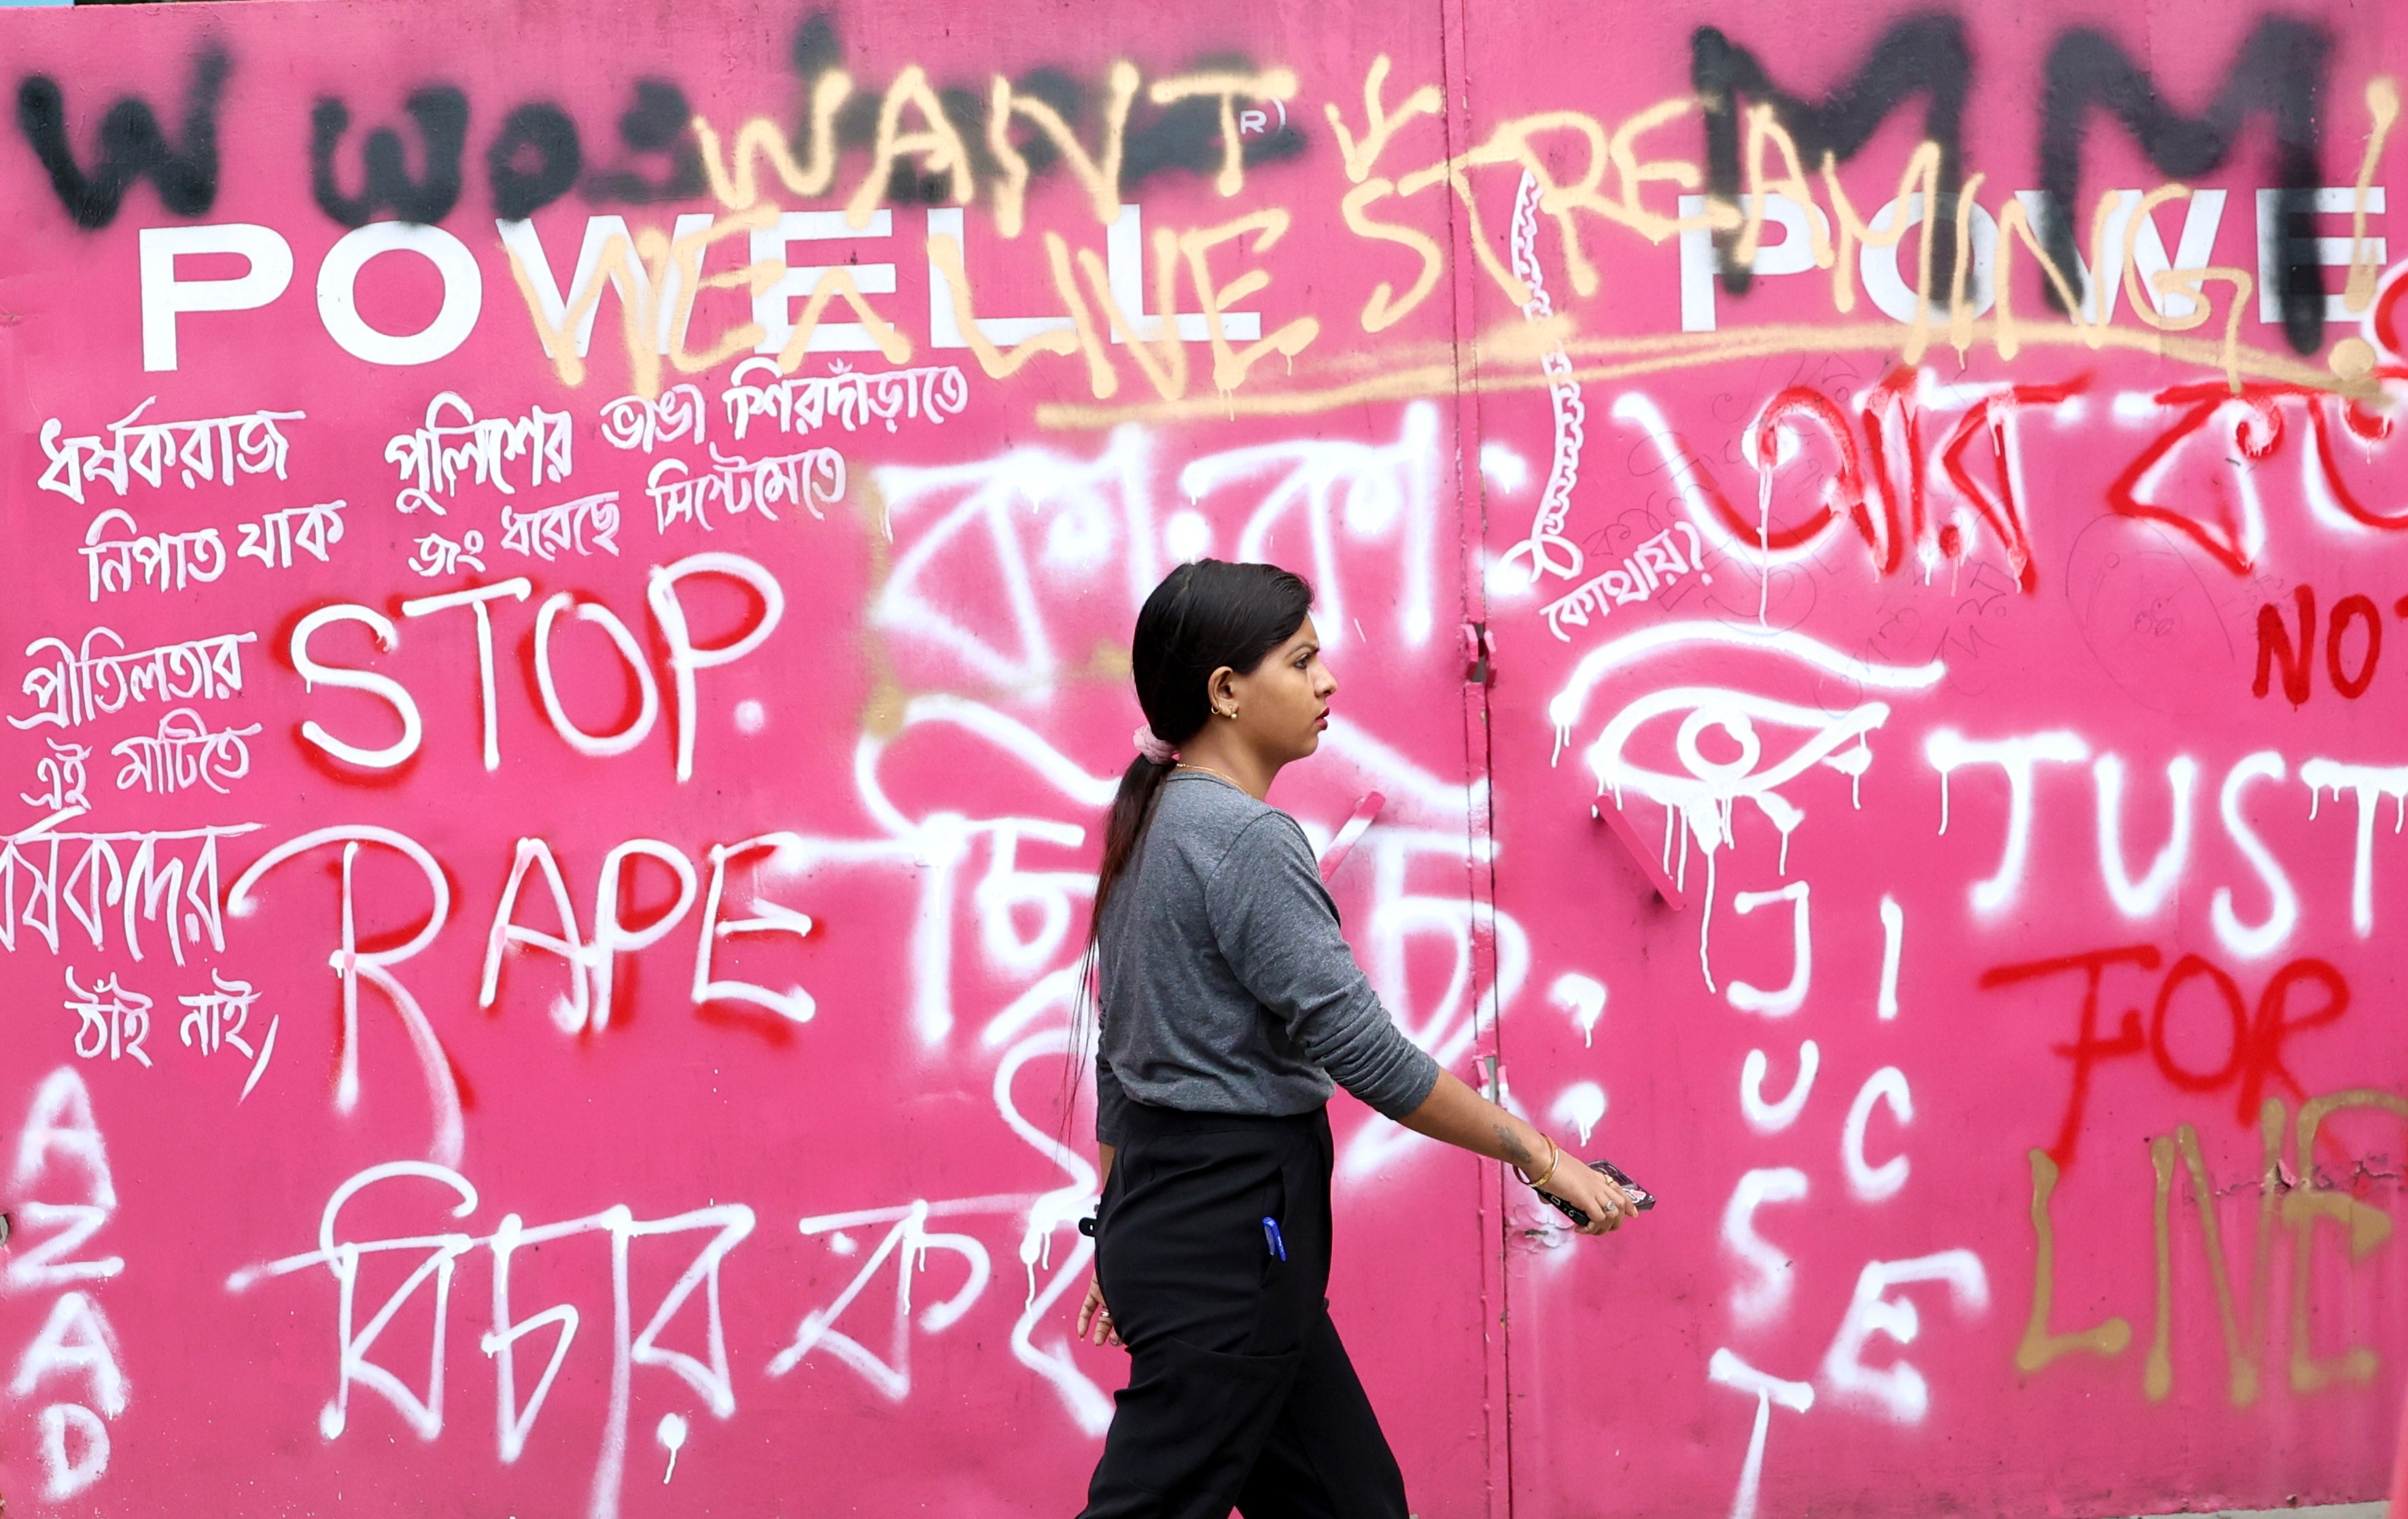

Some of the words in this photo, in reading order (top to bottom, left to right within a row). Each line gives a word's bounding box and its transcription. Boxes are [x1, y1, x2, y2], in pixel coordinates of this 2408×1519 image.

[691, 58, 1296, 238] WANT
[139, 203, 1261, 371] POWELL
[77, 508, 226, 601] নিপাত
[237, 499, 347, 568] যাক
[2250, 583, 2408, 712] NO
[111, 708, 262, 795] মাটিতে
[226, 824, 820, 1174] RAPE
[1978, 944, 2353, 1172] FOR
